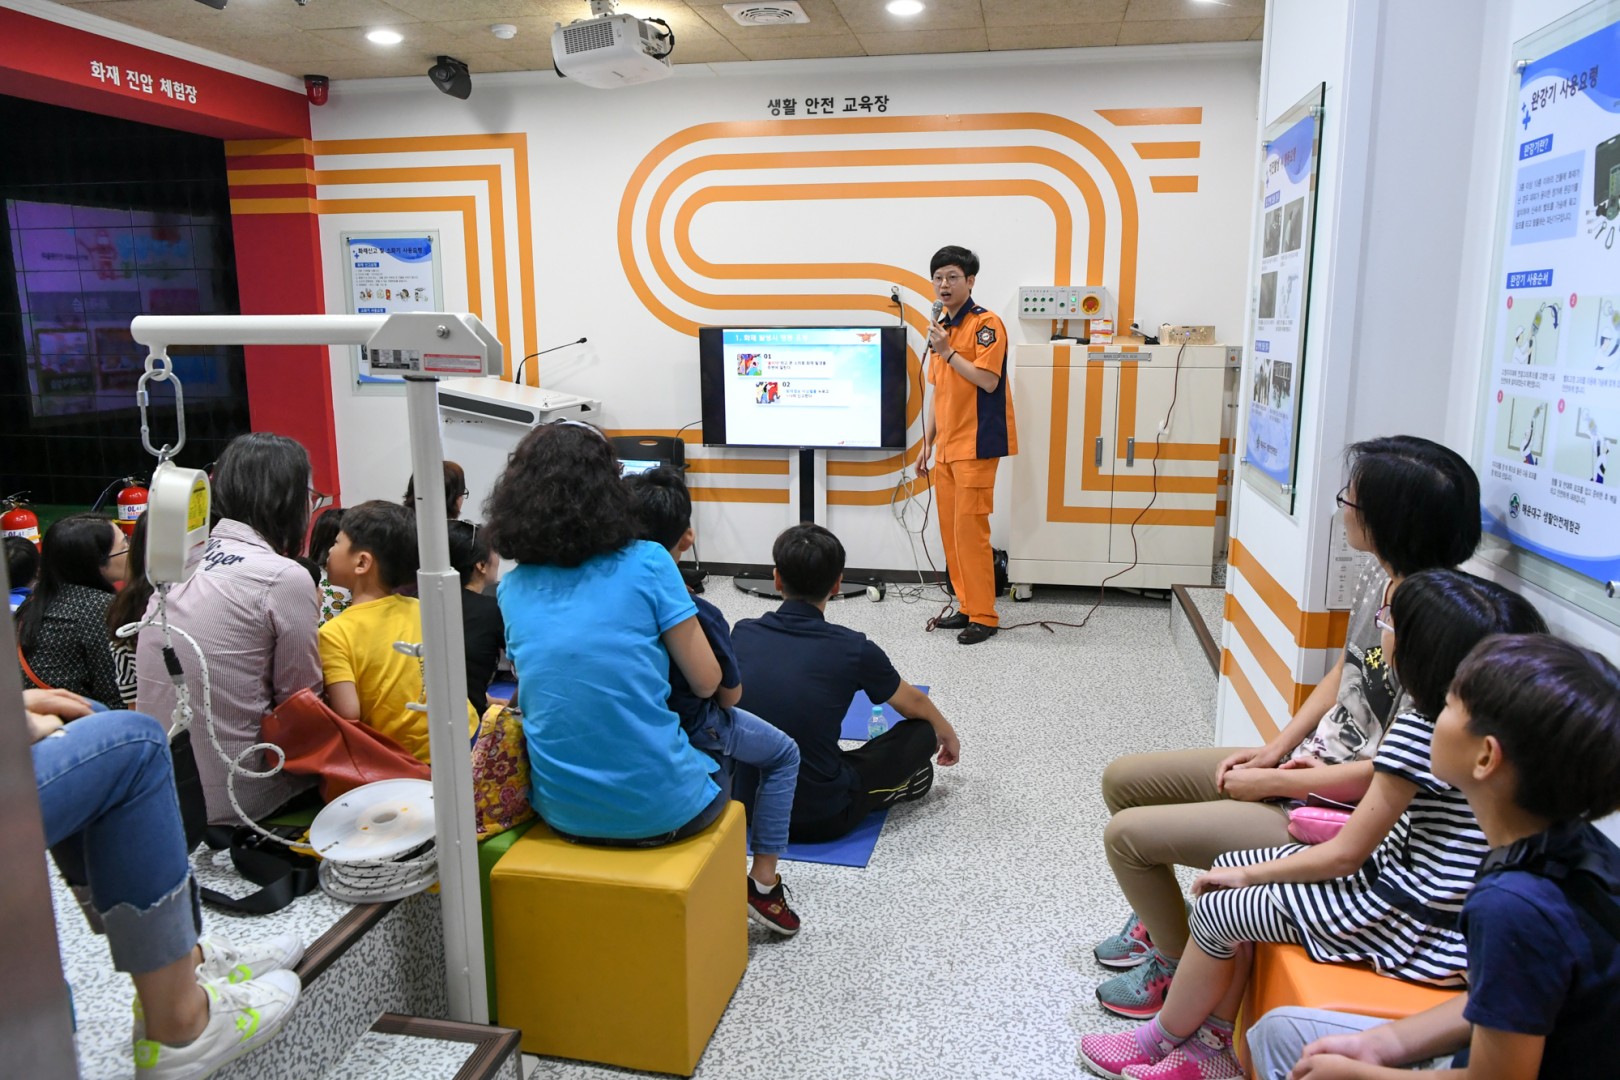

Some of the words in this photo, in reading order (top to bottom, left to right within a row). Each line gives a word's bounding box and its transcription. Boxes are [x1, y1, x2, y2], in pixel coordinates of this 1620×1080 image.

[90, 60, 120, 87] 화재
[126, 69, 153, 94] 진압
[159, 77, 198, 104] 체험장
[1531, 82, 1557, 112] 완강기
[1559, 64, 1599, 99] 사용요령
[767, 98, 797, 116] 생활
[805, 97, 834, 115] 안전
[842, 95, 890, 113] 교육장
[1522, 504, 1542, 520] 해운대구
[1543, 511, 1581, 535] 생활안전체험관
